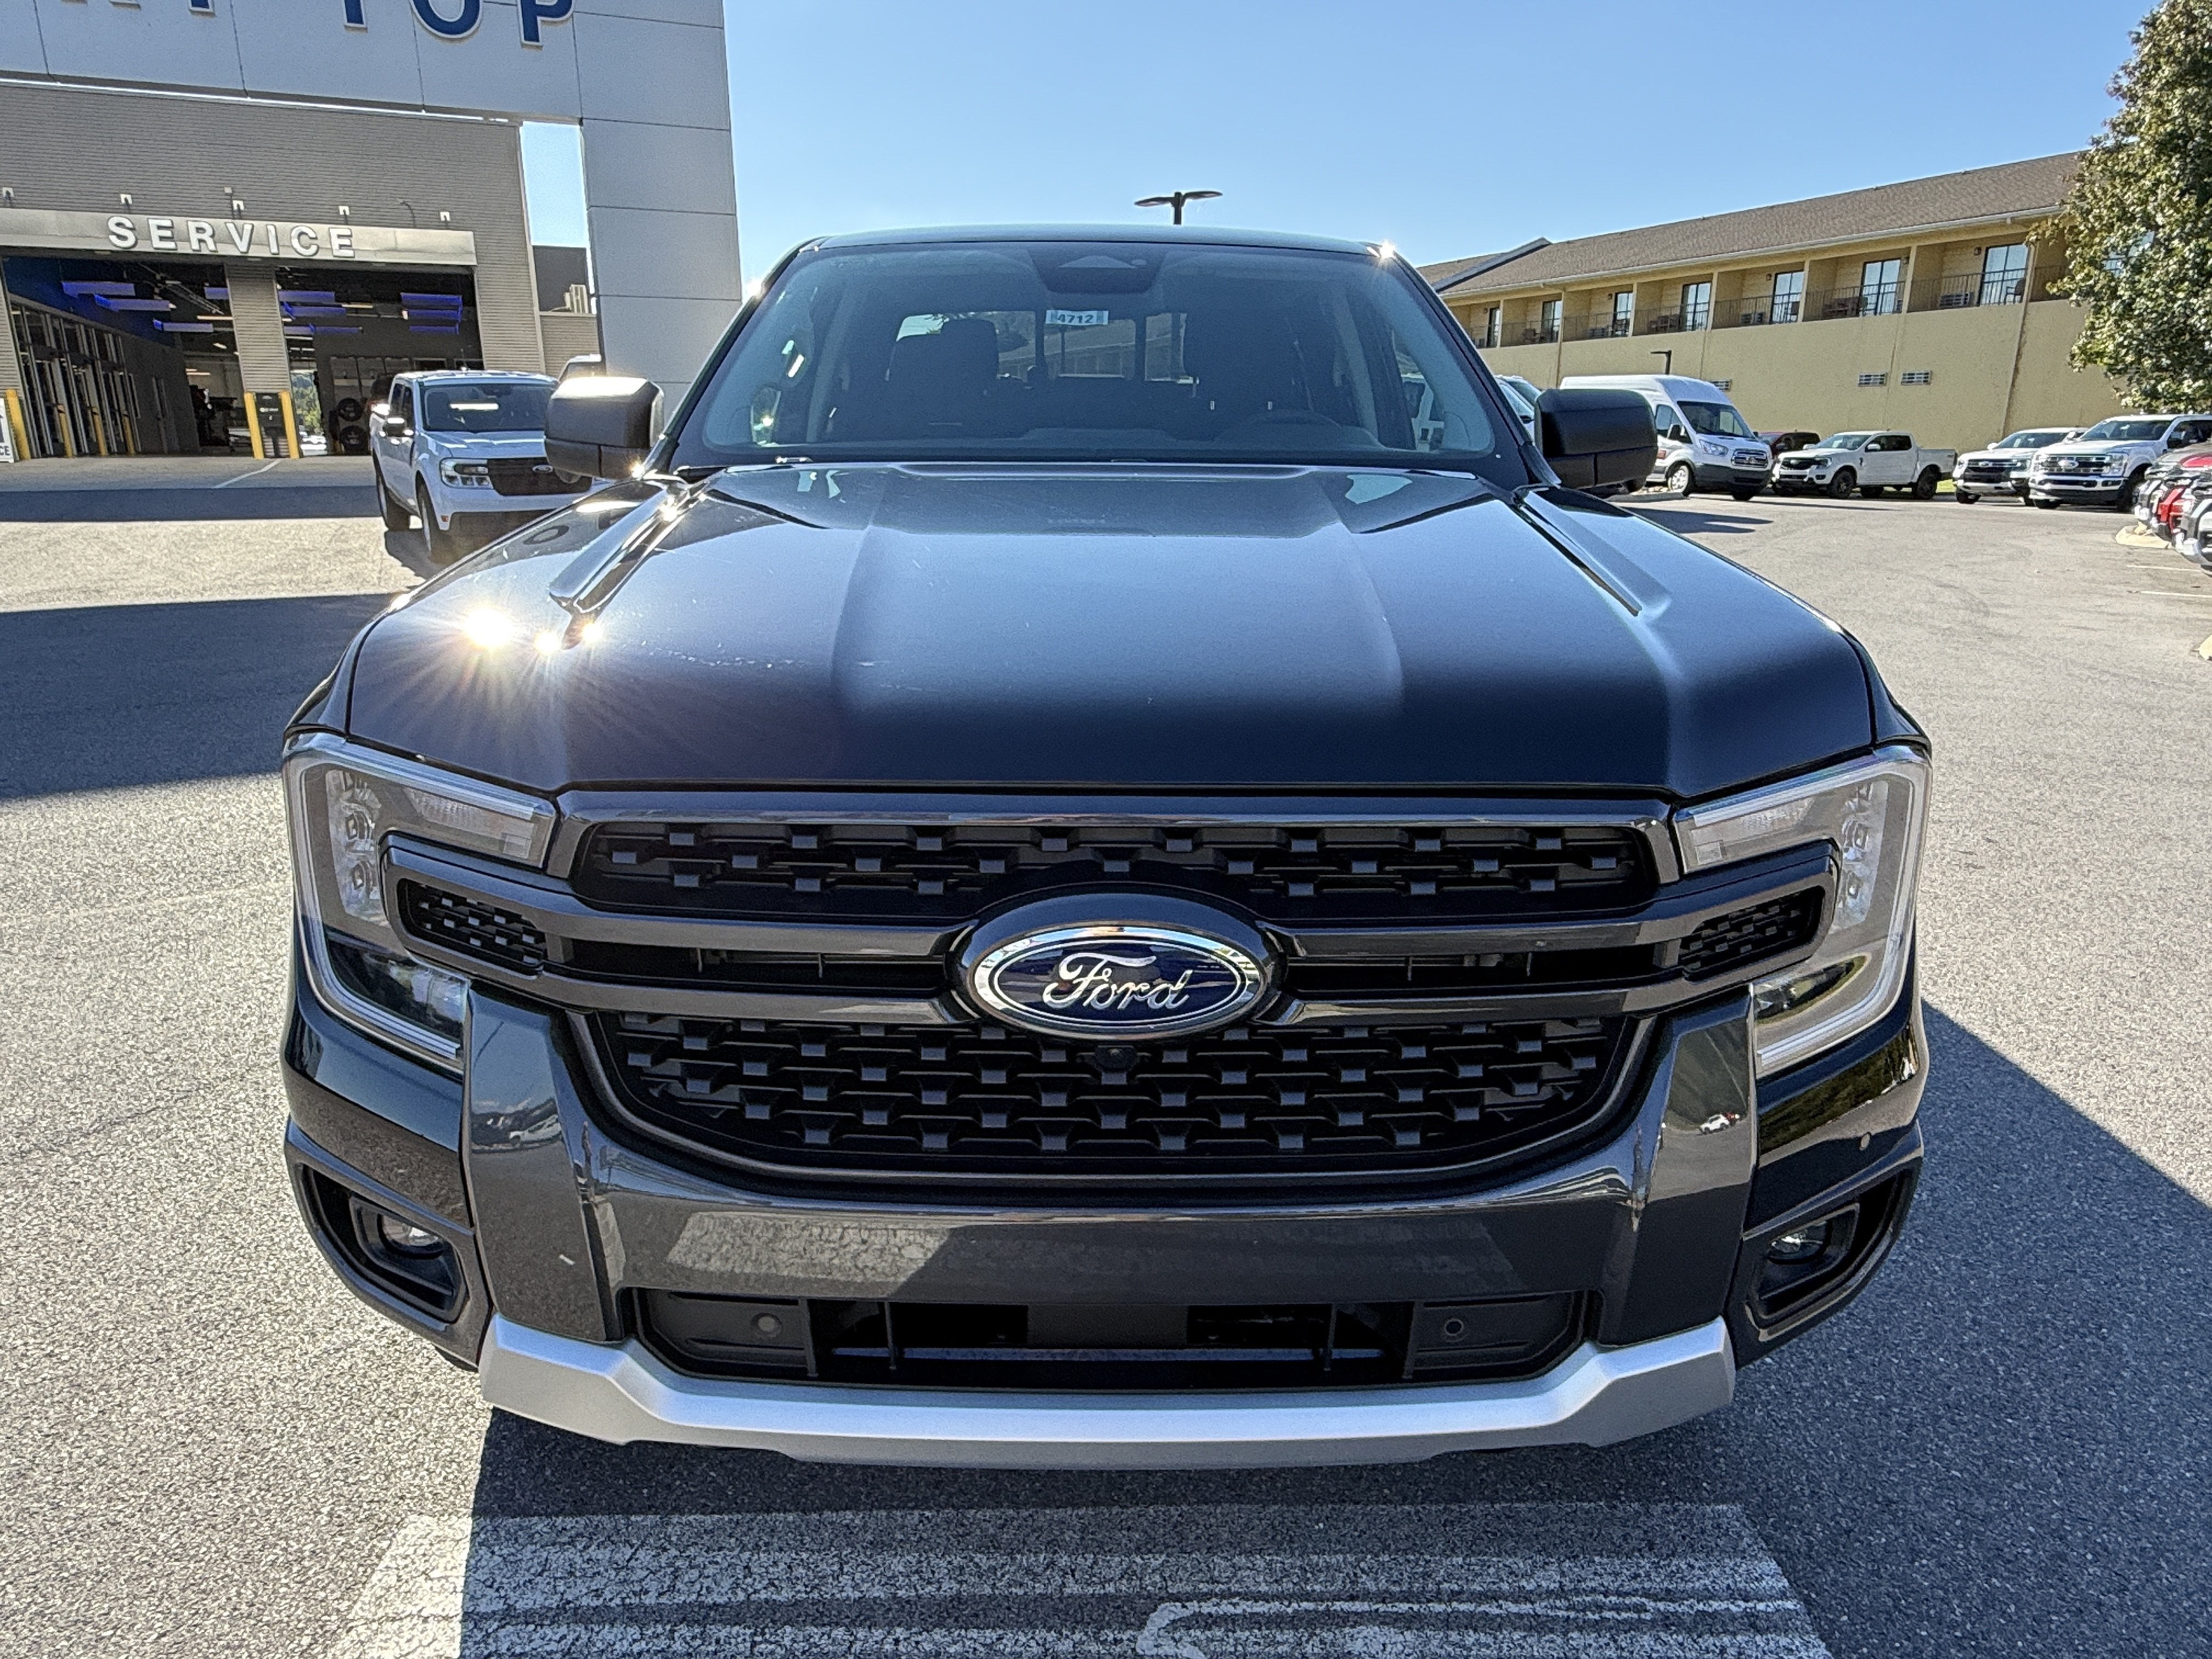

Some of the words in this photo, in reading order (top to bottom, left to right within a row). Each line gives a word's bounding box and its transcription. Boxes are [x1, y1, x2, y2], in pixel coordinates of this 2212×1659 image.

[108, 216, 355, 258] SERVICE
[1057, 314, 1094, 324] 4712
[1043, 952, 1194, 1011] Ford
